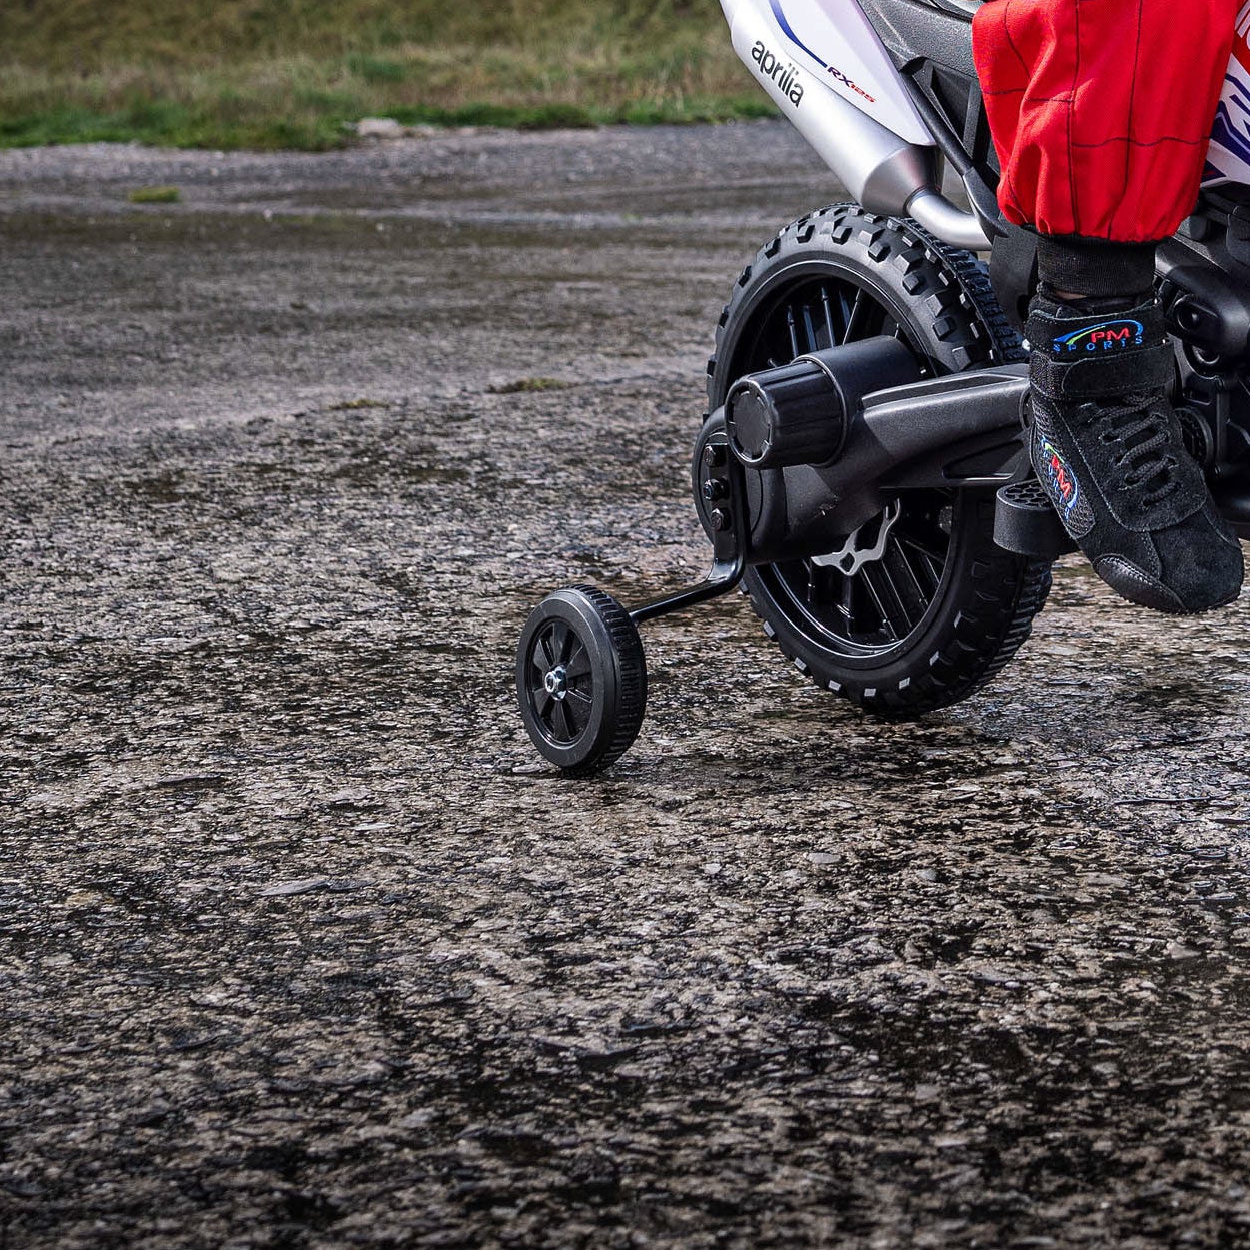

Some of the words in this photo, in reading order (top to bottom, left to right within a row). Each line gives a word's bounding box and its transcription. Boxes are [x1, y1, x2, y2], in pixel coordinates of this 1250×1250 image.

[751, 40, 805, 108] aprilia
[1053, 334, 1144, 352] SPORTS
[1091, 327, 1132, 344] PM
